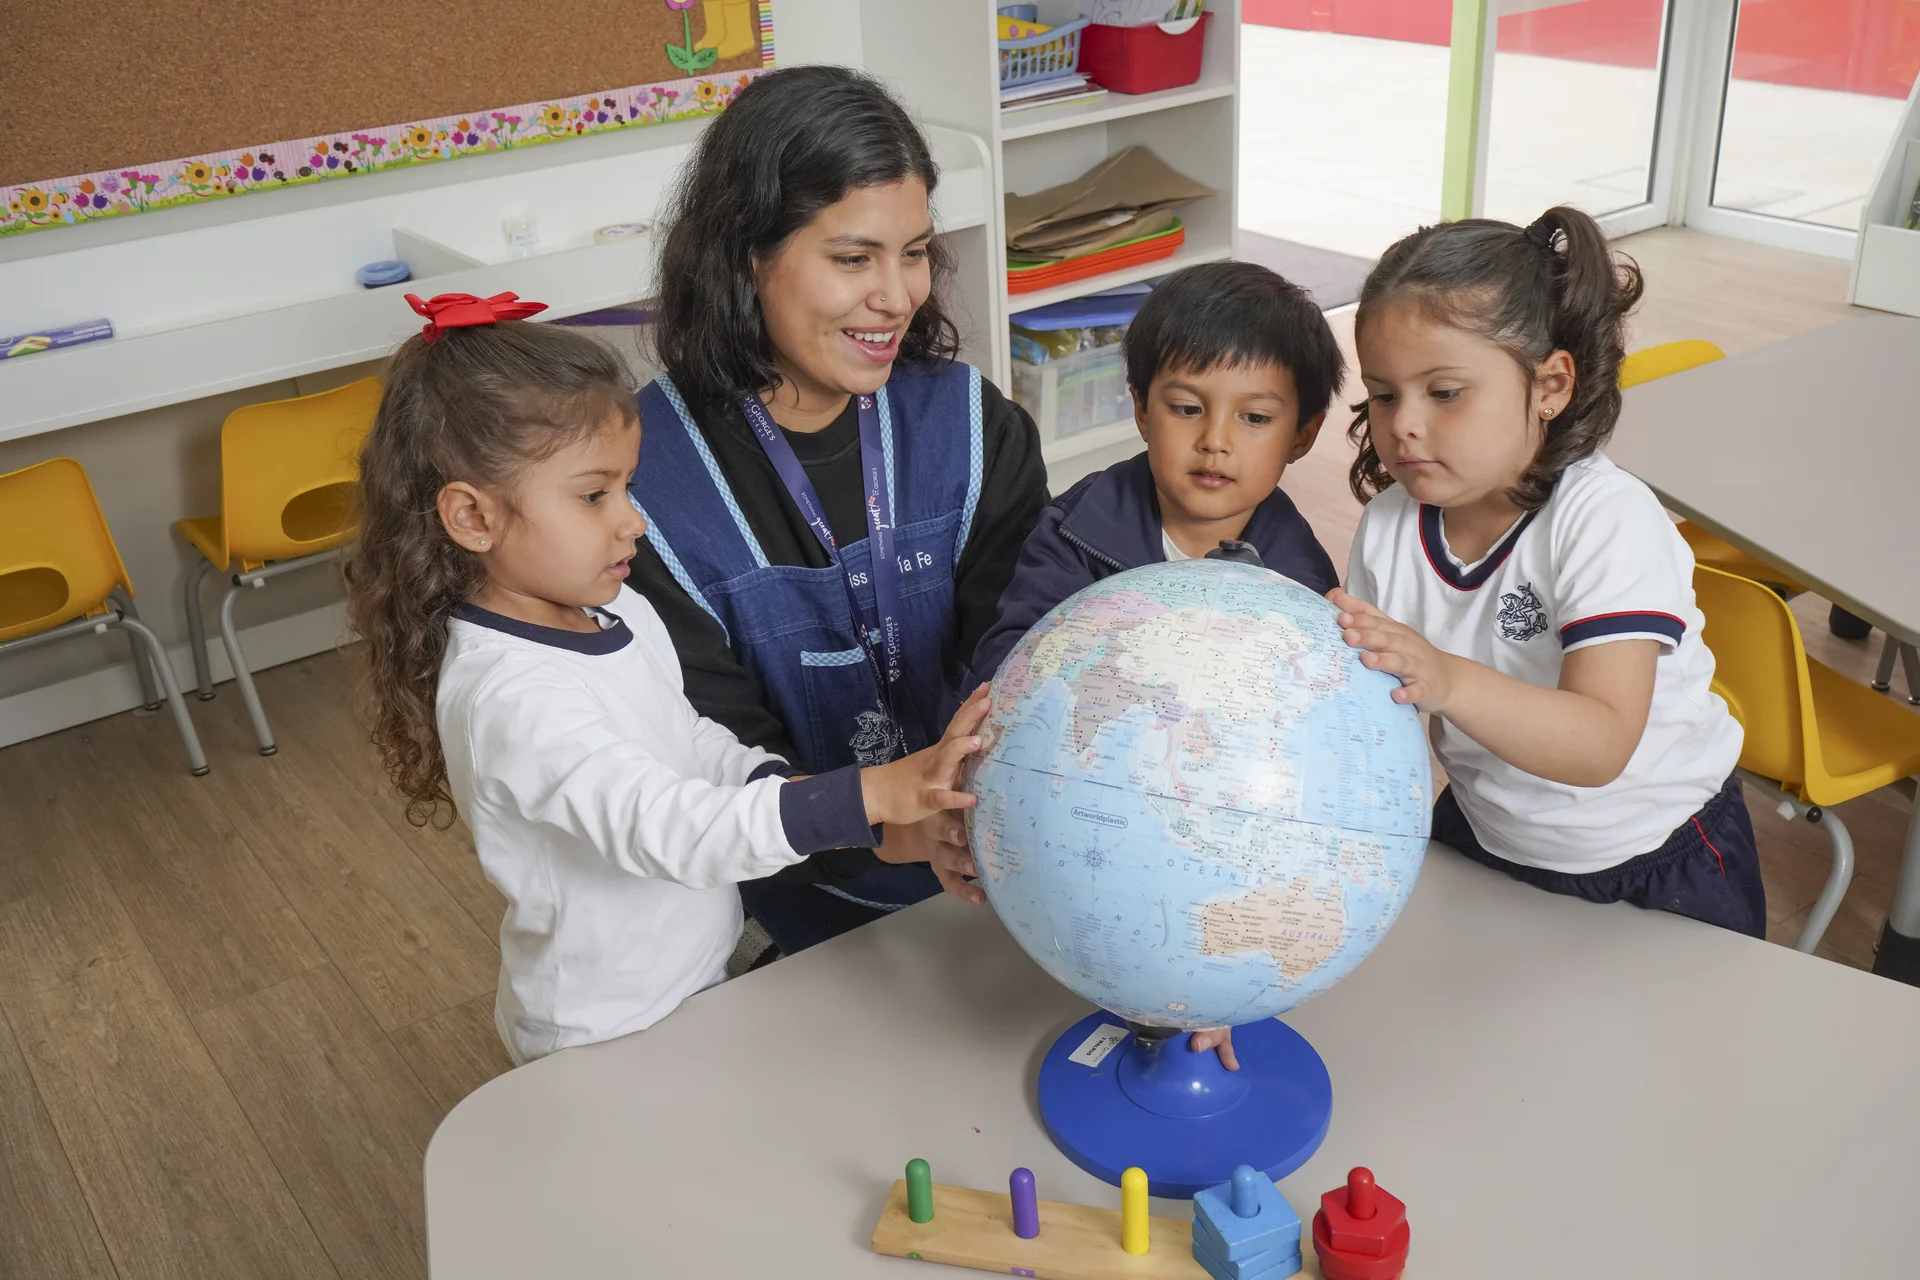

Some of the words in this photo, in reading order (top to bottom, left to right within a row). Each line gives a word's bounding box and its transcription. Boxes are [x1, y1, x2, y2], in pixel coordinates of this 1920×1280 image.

[743, 403, 765, 438] COLLEGE
[751, 404, 776, 441] GEORGE'S
[801, 491, 818, 518] SOMETHING
[868, 503, 890, 531] great!
[877, 531, 886, 560] SOMETHING
[848, 572, 868, 589] iss
[916, 551, 933, 569] Fe
[1157, 581, 1207, 593] RUSIA
[885, 616, 896, 655] GEORGE'S
[1140, 628, 1185, 642] ASIA
[889, 654, 897, 667] ST.
[1073, 808, 1126, 826] Artworldplastic
[1167, 859, 1262, 885] OCEANIA
[1281, 928, 1340, 942] AUSTRALIA
